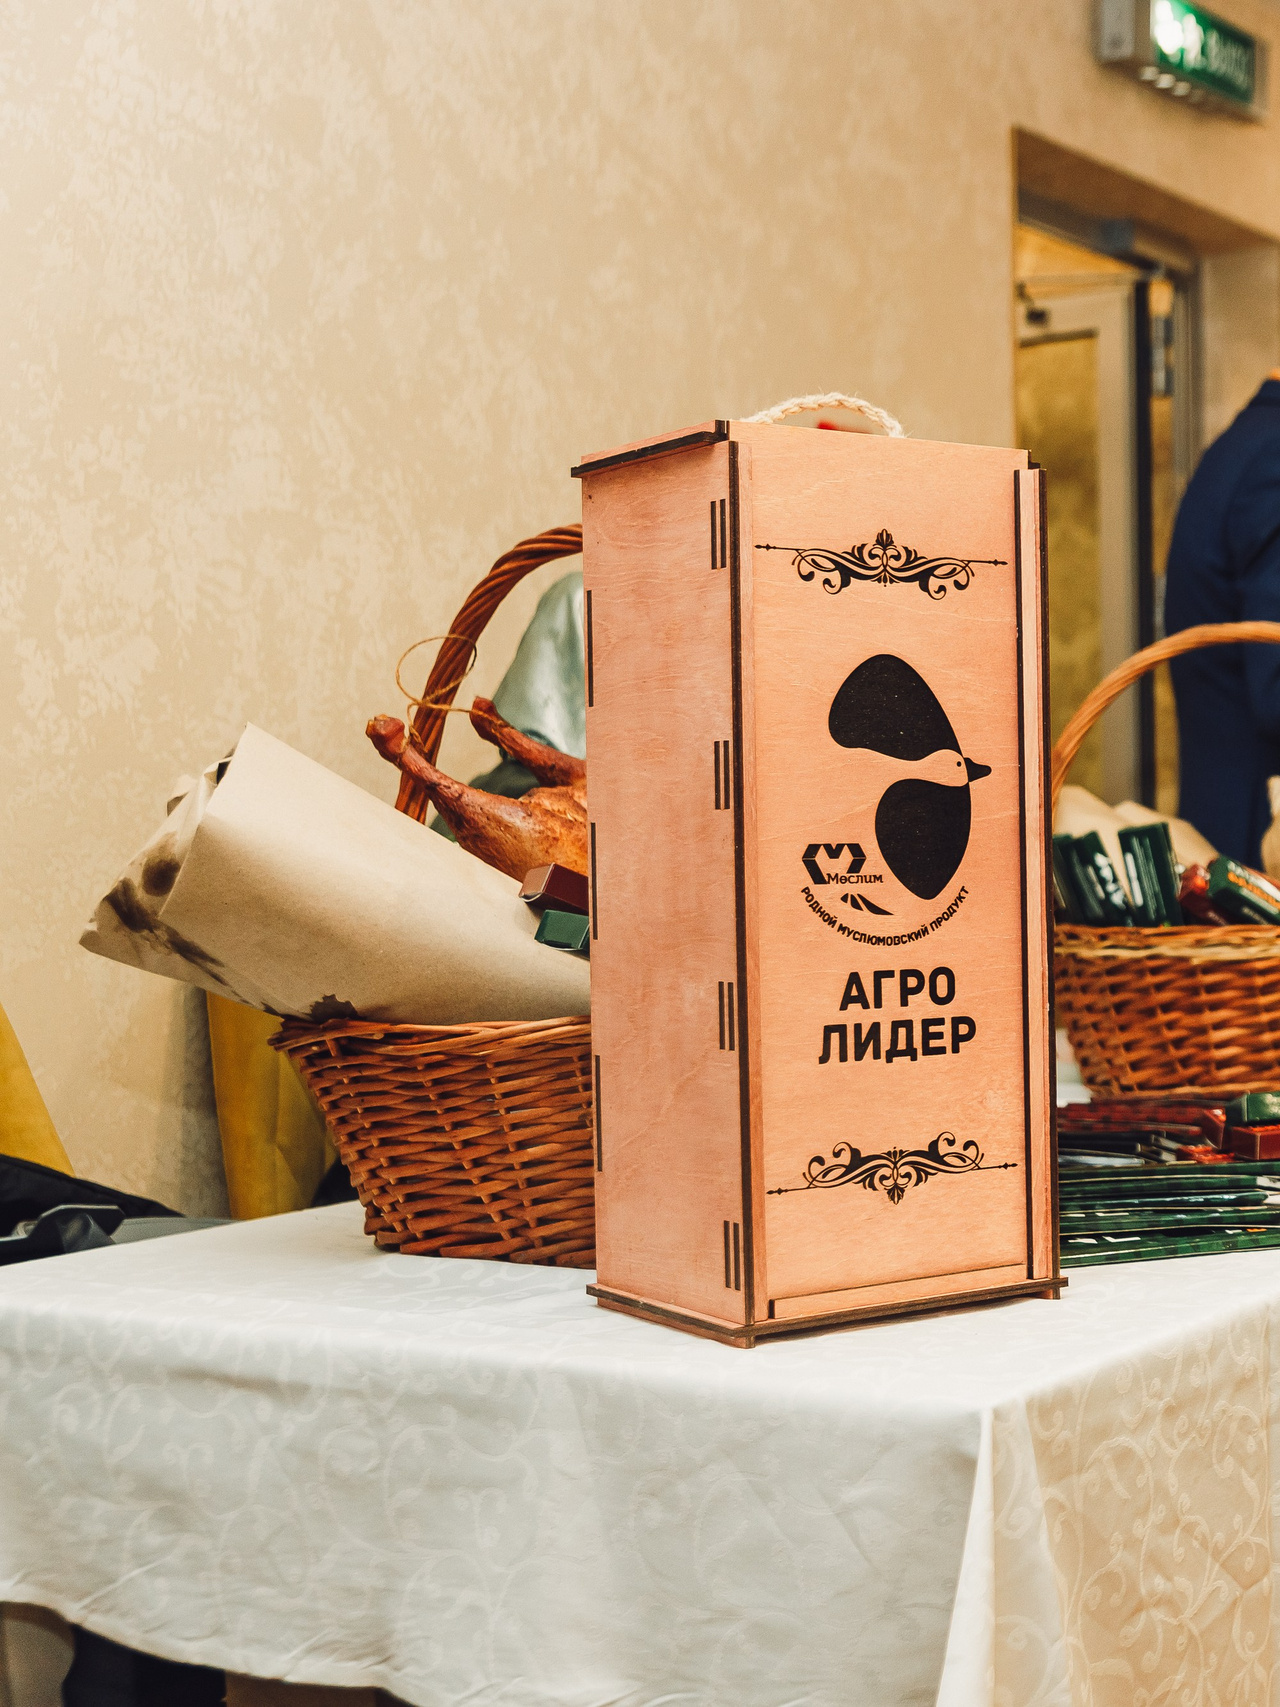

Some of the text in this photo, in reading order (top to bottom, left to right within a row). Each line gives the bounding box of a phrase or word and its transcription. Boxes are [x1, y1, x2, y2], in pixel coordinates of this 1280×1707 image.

[826, 873, 884, 885] Мөслим
[801, 885, 970, 947] РОДНОЙ МУСЛЮМОВСКИЙ ПРОДУКТ
[839, 966, 956, 1011] АГРО
[818, 1016, 977, 1065] ЛИДЕР
